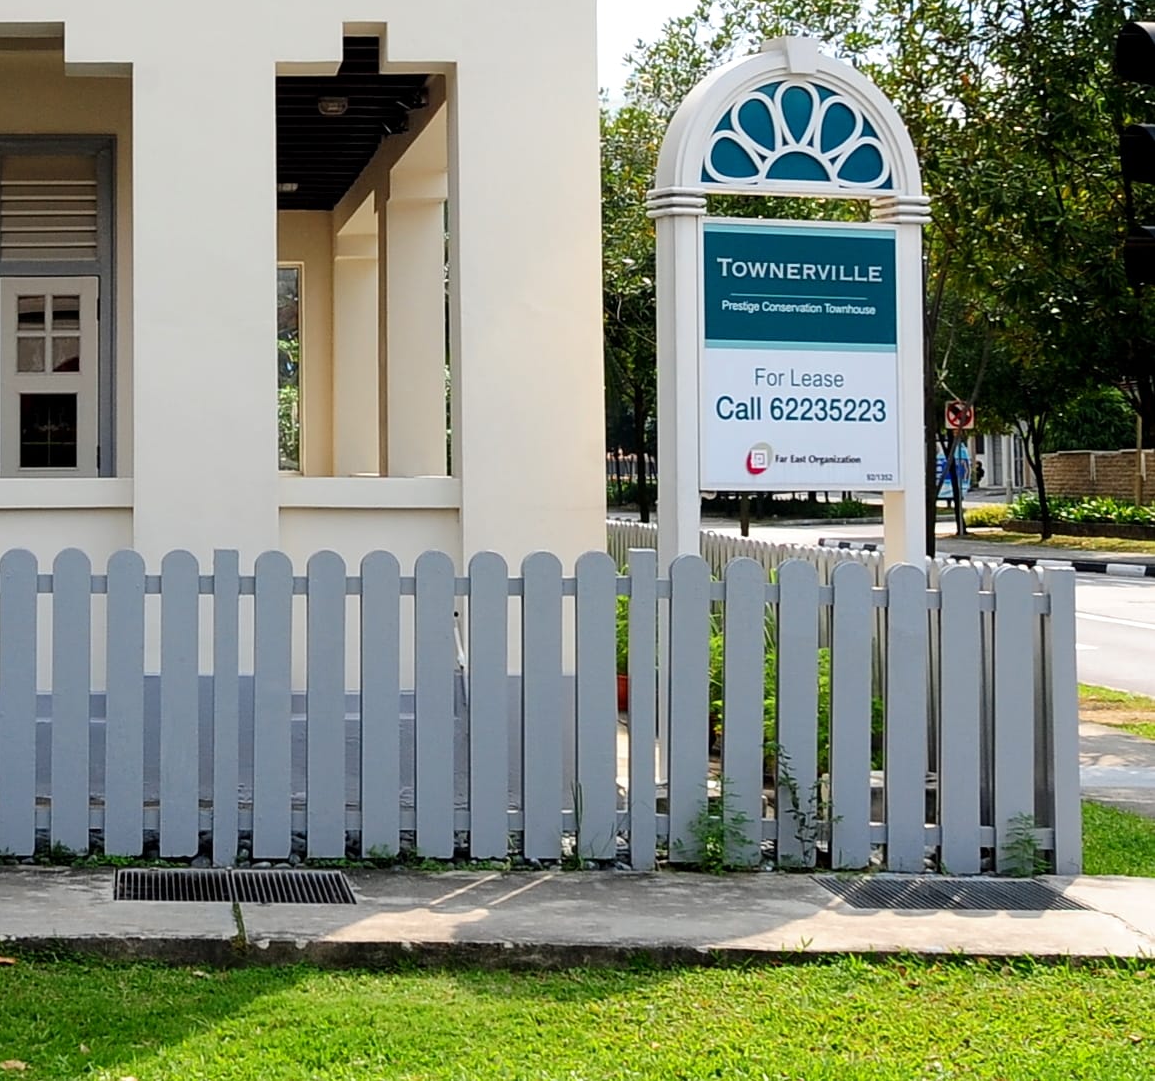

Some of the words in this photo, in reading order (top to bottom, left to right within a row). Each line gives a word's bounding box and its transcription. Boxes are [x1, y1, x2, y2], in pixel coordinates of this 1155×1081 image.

[716, 257, 883, 283] TOWNERVILLE
[721, 300, 760, 314] Prestige
[761, 301, 823, 313] Conservation
[824, 303, 876, 315] Townhouse
[754, 368, 785, 387] For
[790, 369, 844, 388] Lease
[716, 396, 761, 420] Call
[770, 398, 887, 422] 62235223
[775, 454, 788, 463] Far
[790, 455, 806, 463] East
[808, 455, 861, 466] Organization
